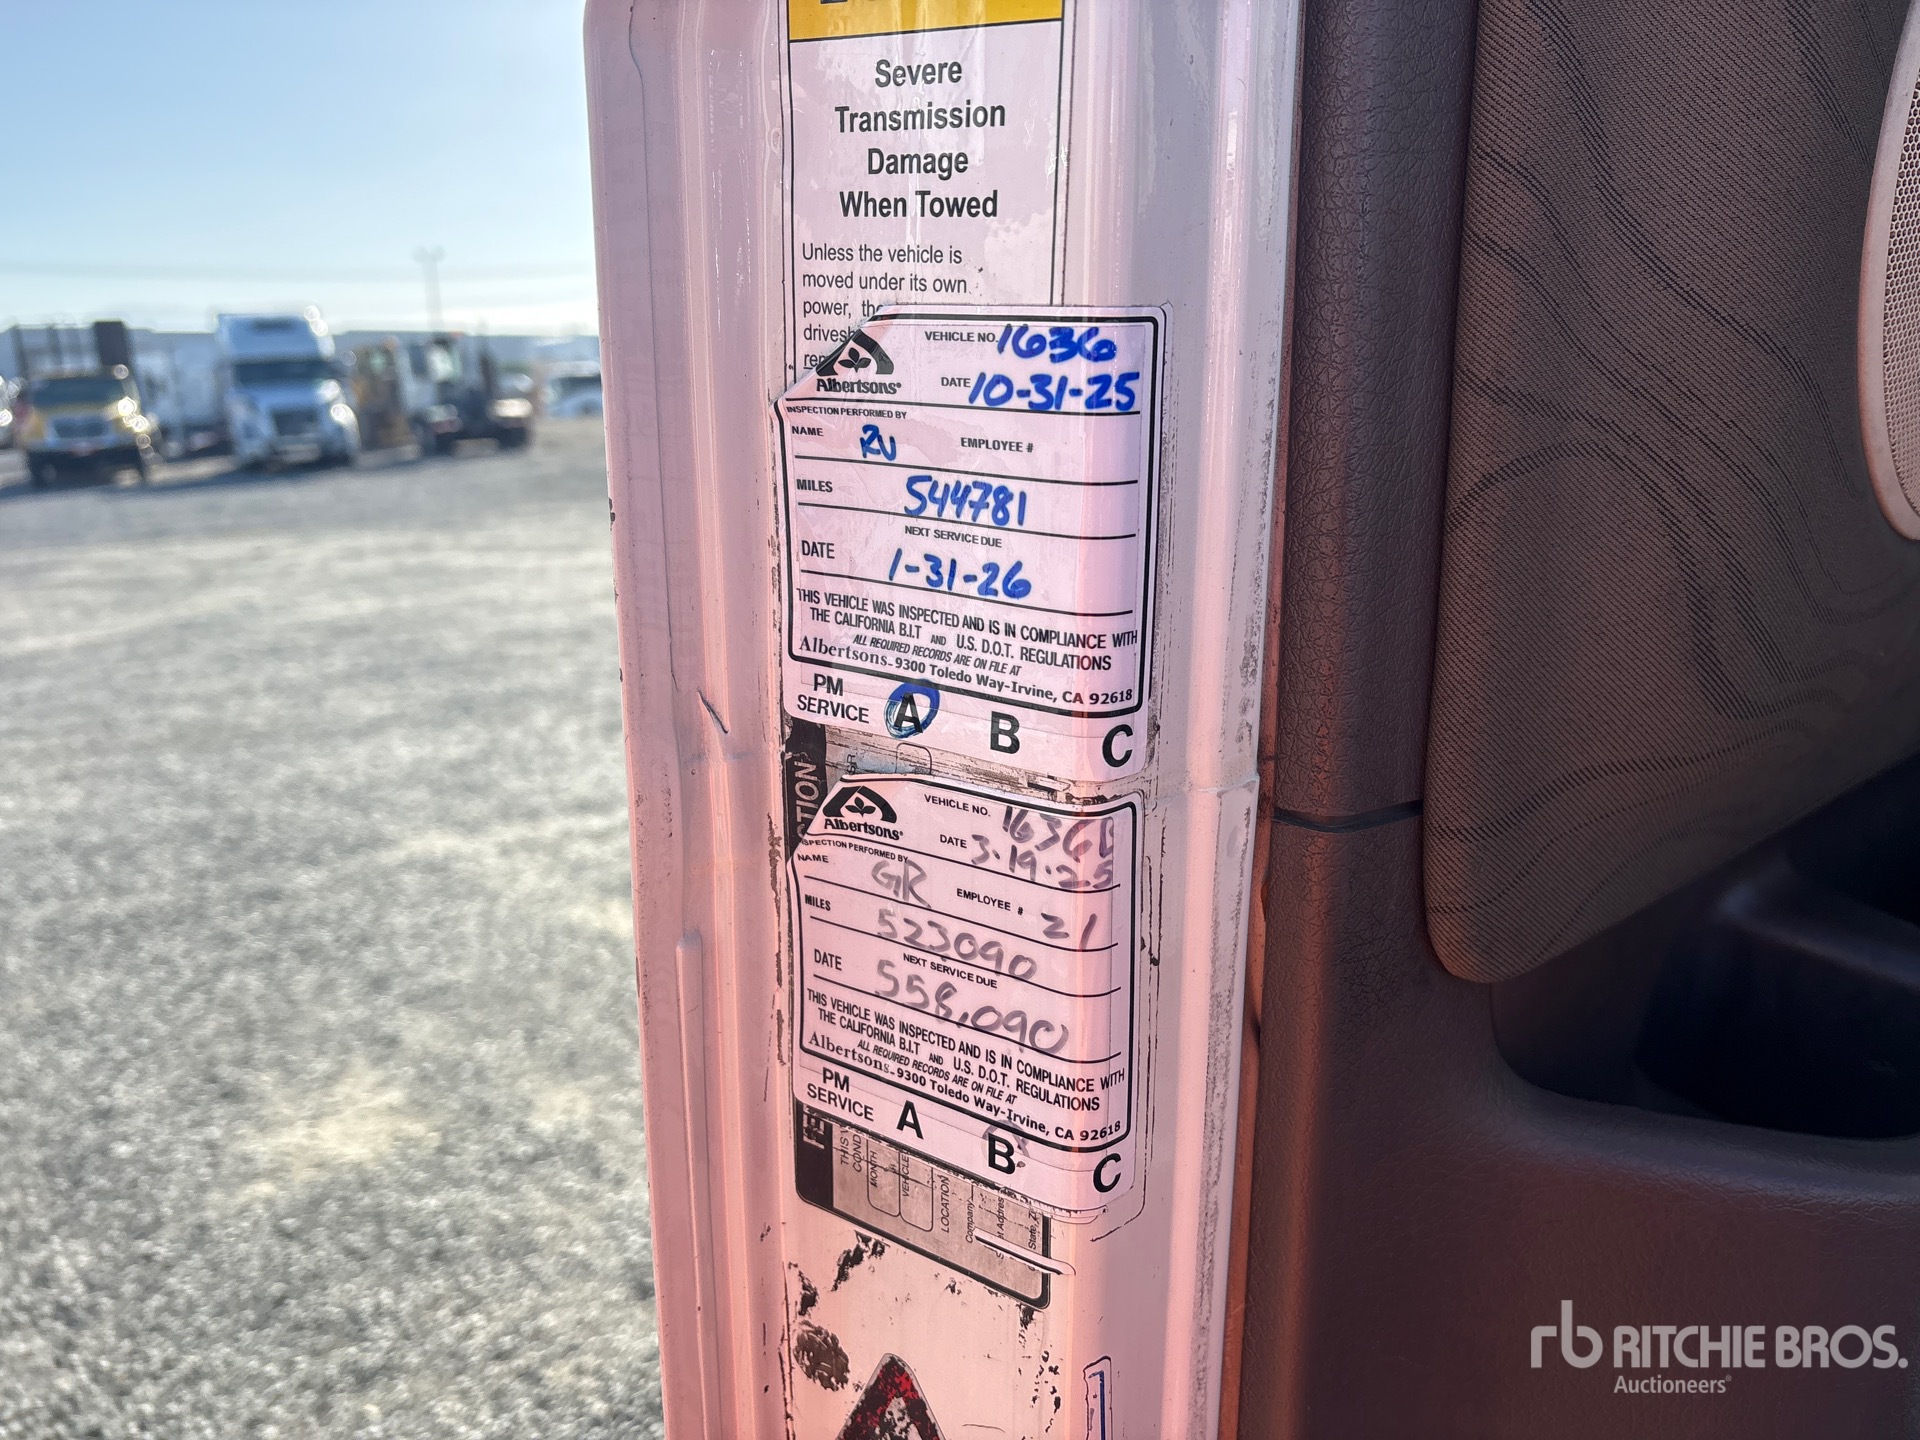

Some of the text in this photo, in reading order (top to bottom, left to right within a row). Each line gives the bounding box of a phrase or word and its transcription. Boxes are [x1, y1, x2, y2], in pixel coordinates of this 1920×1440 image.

[875, 59, 962, 87] Severe
[835, 100, 1006, 132] Transmission
[867, 148, 969, 181] Damage
[839, 190, 998, 218] When Towed
[802, 243, 962, 264] Unless the vehicle is
[802, 271, 967, 293] moved under its own
[803, 300, 851, 319] power,
[925, 331, 999, 343] VEHICLE NO.
[997, 324, 1117, 363] 1636
[941, 377, 971, 388] DATE
[968, 372, 1140, 411] 10-31-25
[787, 406, 907, 419] INSPECTION PERFORMED BY
[792, 425, 824, 436] NAME
[960, 437, 1034, 453] EMPLOYEE #
[796, 479, 833, 493] MILES
[904, 475, 1027, 526] 544781
[801, 540, 835, 559] DATE
[905, 526, 1002, 548] NEXT SERVICE DUE
[889, 548, 1032, 600] 1-31-26
[797, 588, 1138, 649] THIS VEHICLE WAS INSPECTED AND IS IN COMPLIANCE WITH
[810, 607, 830, 622] THE
[834, 611, 895, 635] CALIFORNIA
[930, 634, 947, 646] AND
[956, 634, 977, 651] U.S.
[981, 638, 1014, 658] D.O.T.
[1020, 647, 1111, 671] REGULATIONS
[853, 634, 1022, 676] ALL REQUIRED RECORDS ARE ON FILE AT
[813, 673, 844, 697] PM
[930, 664, 971, 684] Toledo
[1062, 691, 1084, 704] CA
[1089, 689, 1133, 705] 92618
[797, 694, 870, 724] SERVICE
[893, 692, 1135, 768] A B C
[924, 794, 991, 817] VEHICLE NO.
[848, 842, 896, 860] PERFORMED
[897, 854, 909, 864] BY
[939, 834, 967, 849] DATE
[797, 853, 829, 864] NAME
[805, 894, 831, 911] MILES
[956, 888, 1024, 915] EMPLOYEE #
[877, 908, 1038, 981] 523090
[1040, 912, 1098, 950] 21
[814, 949, 842, 971] DATE
[903, 952, 998, 989] NEXT SERVICE DUE
[807, 988, 1125, 1093] THIS VEHICLE WAS INSPECTED AND IS IN COMPLIANCE WITH
[818, 1007, 836, 1026] THE
[839, 1015, 896, 1047] CALIFORNIA
[929, 1053, 944, 1065] AND
[953, 1056, 974, 1076] U.S.
[978, 1065, 1010, 1088] D.O.T.
[1016, 1078, 1100, 1111] REGULATIONS
[857, 1039, 1017, 1105] ALL REQUIRED RECORDS ARE ON FILE AT
[822, 1067, 850, 1093] PM
[807, 1083, 875, 1122] SERVICE
[930, 1079, 970, 1103] Toledo
[1055, 1126, 1075, 1141] CA
[1080, 1120, 1121, 1141] 92618
[840, 1137, 849, 1165] THIS
[896, 1100, 1122, 1193] A B C
[941, 1175, 950, 1233] LOCATION
[965, 1200, 975, 1243] Company
